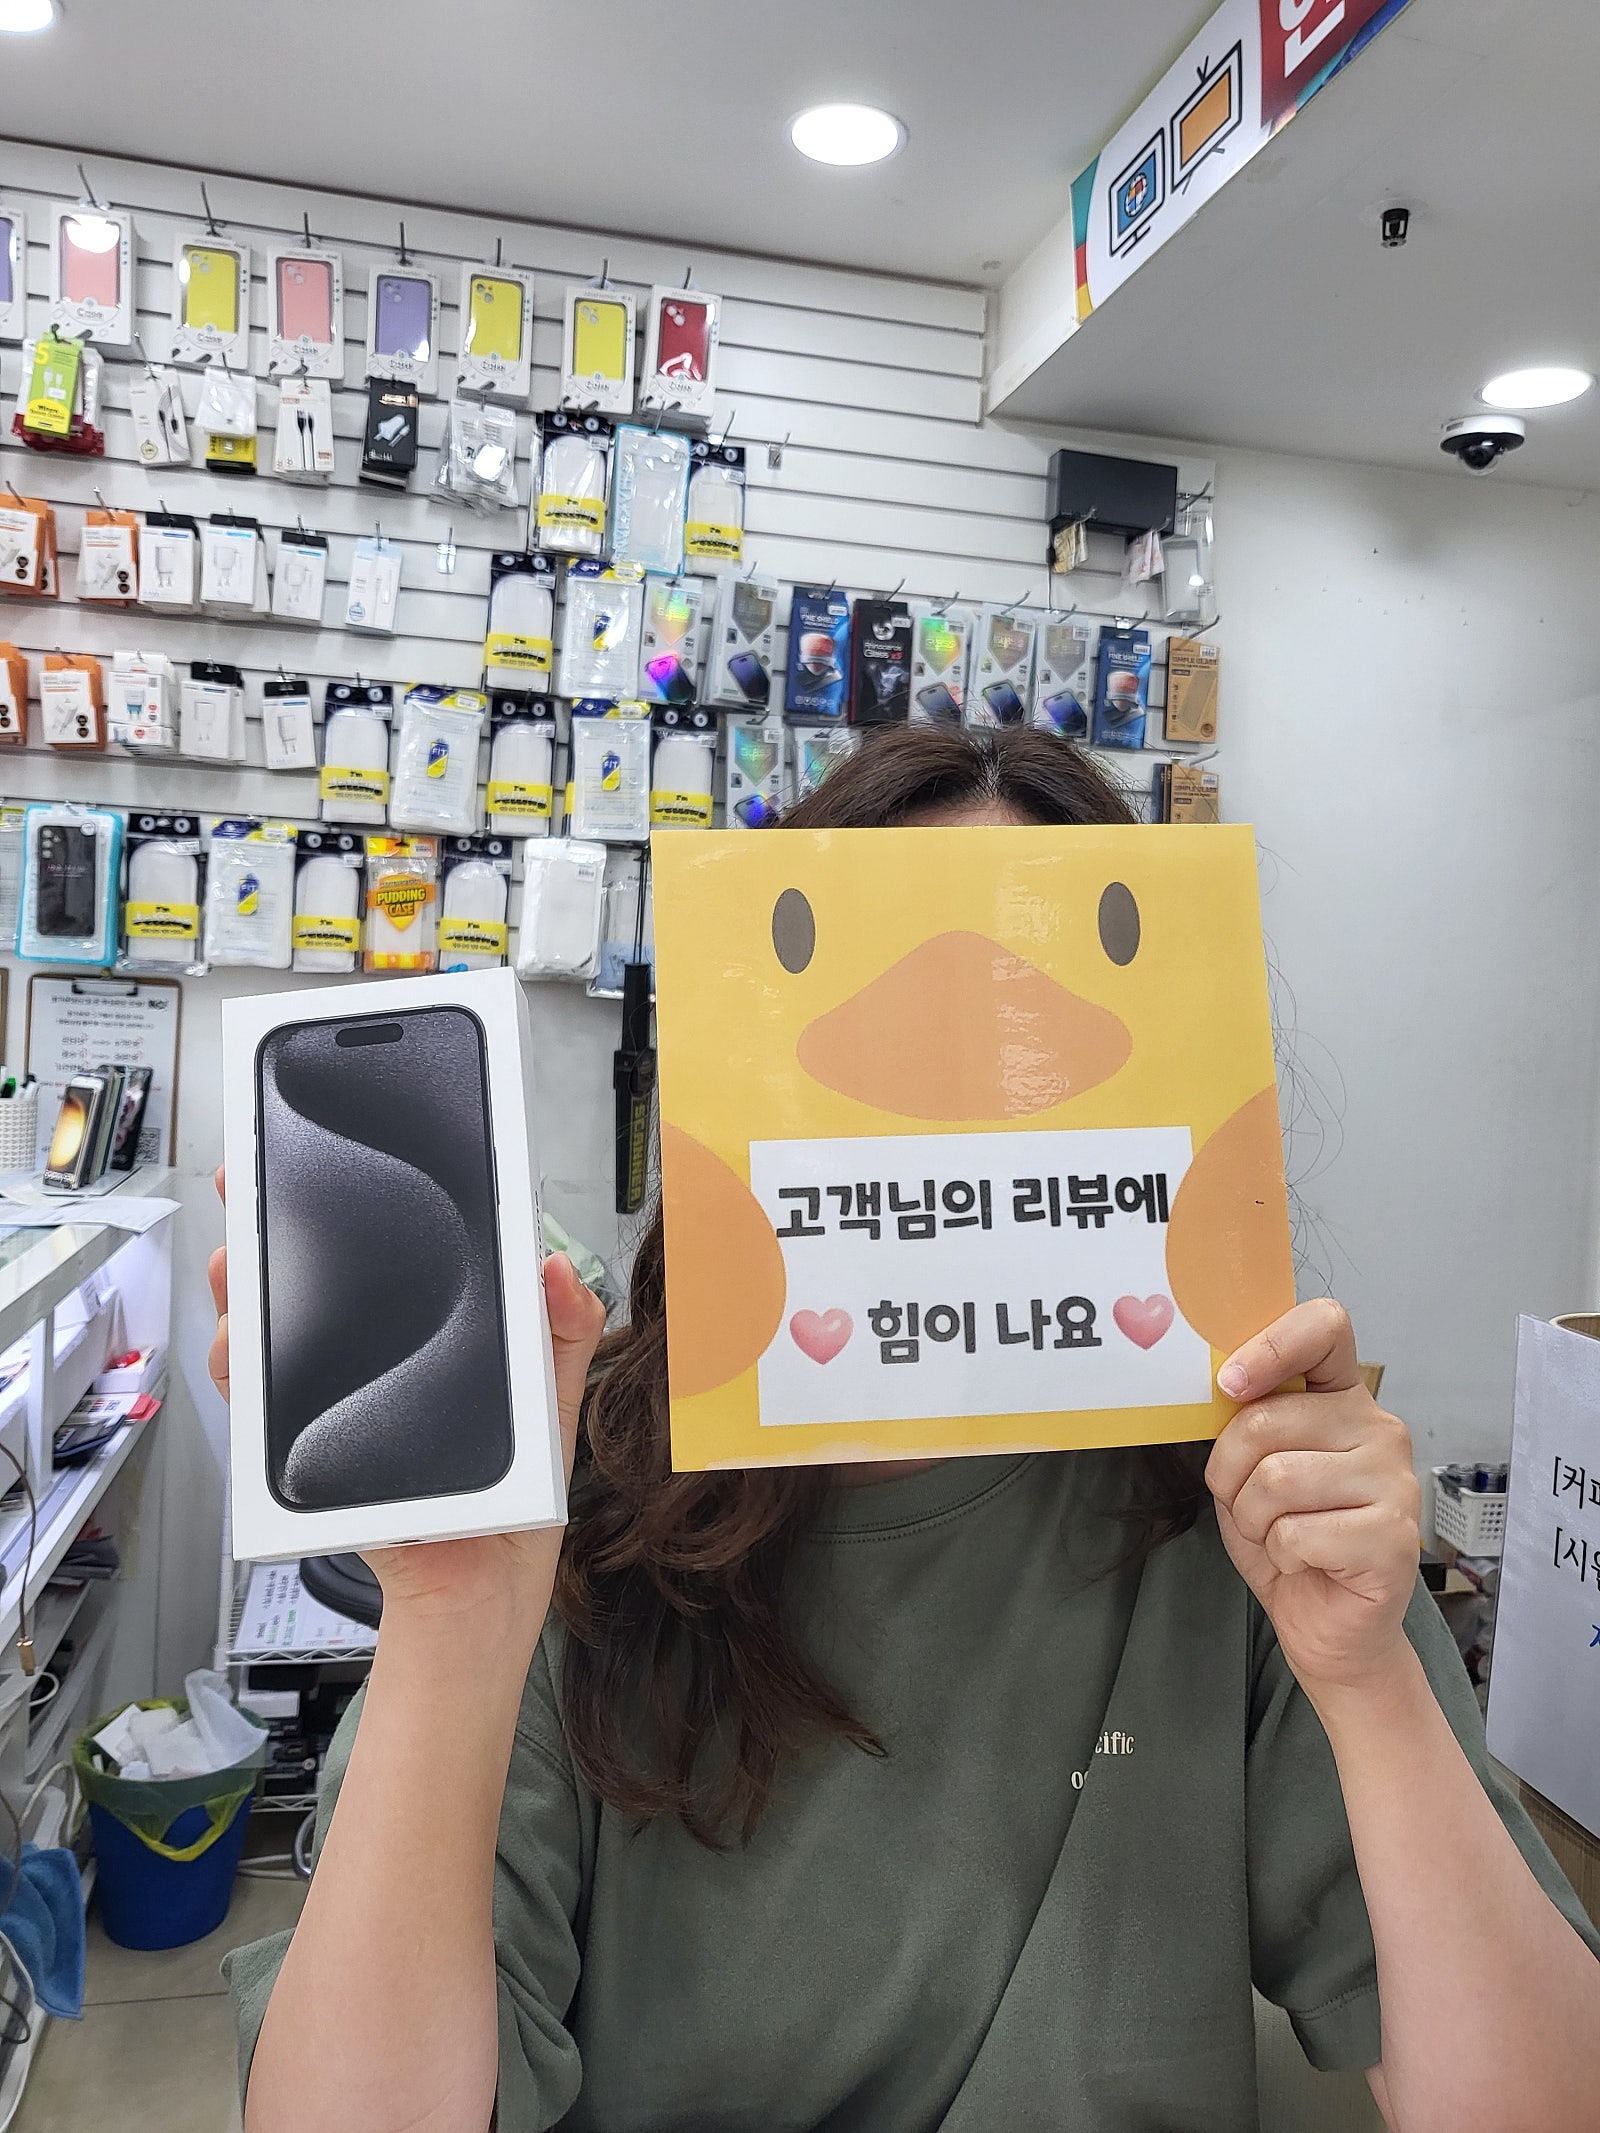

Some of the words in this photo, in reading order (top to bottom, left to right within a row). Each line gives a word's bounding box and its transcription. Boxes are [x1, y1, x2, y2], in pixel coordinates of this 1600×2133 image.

[602, 760, 618, 769] FIT
[376, 887, 426, 906] PUDDING
[388, 902, 415, 917] CASE
[776, 1179, 992, 1240] 고객님의
[1013, 1173, 1169, 1229] 리뷰에
[867, 1300, 976, 1364] 힘이
[996, 1295, 1103, 1350] 나요
[1070, 1771, 1089, 1790] o
